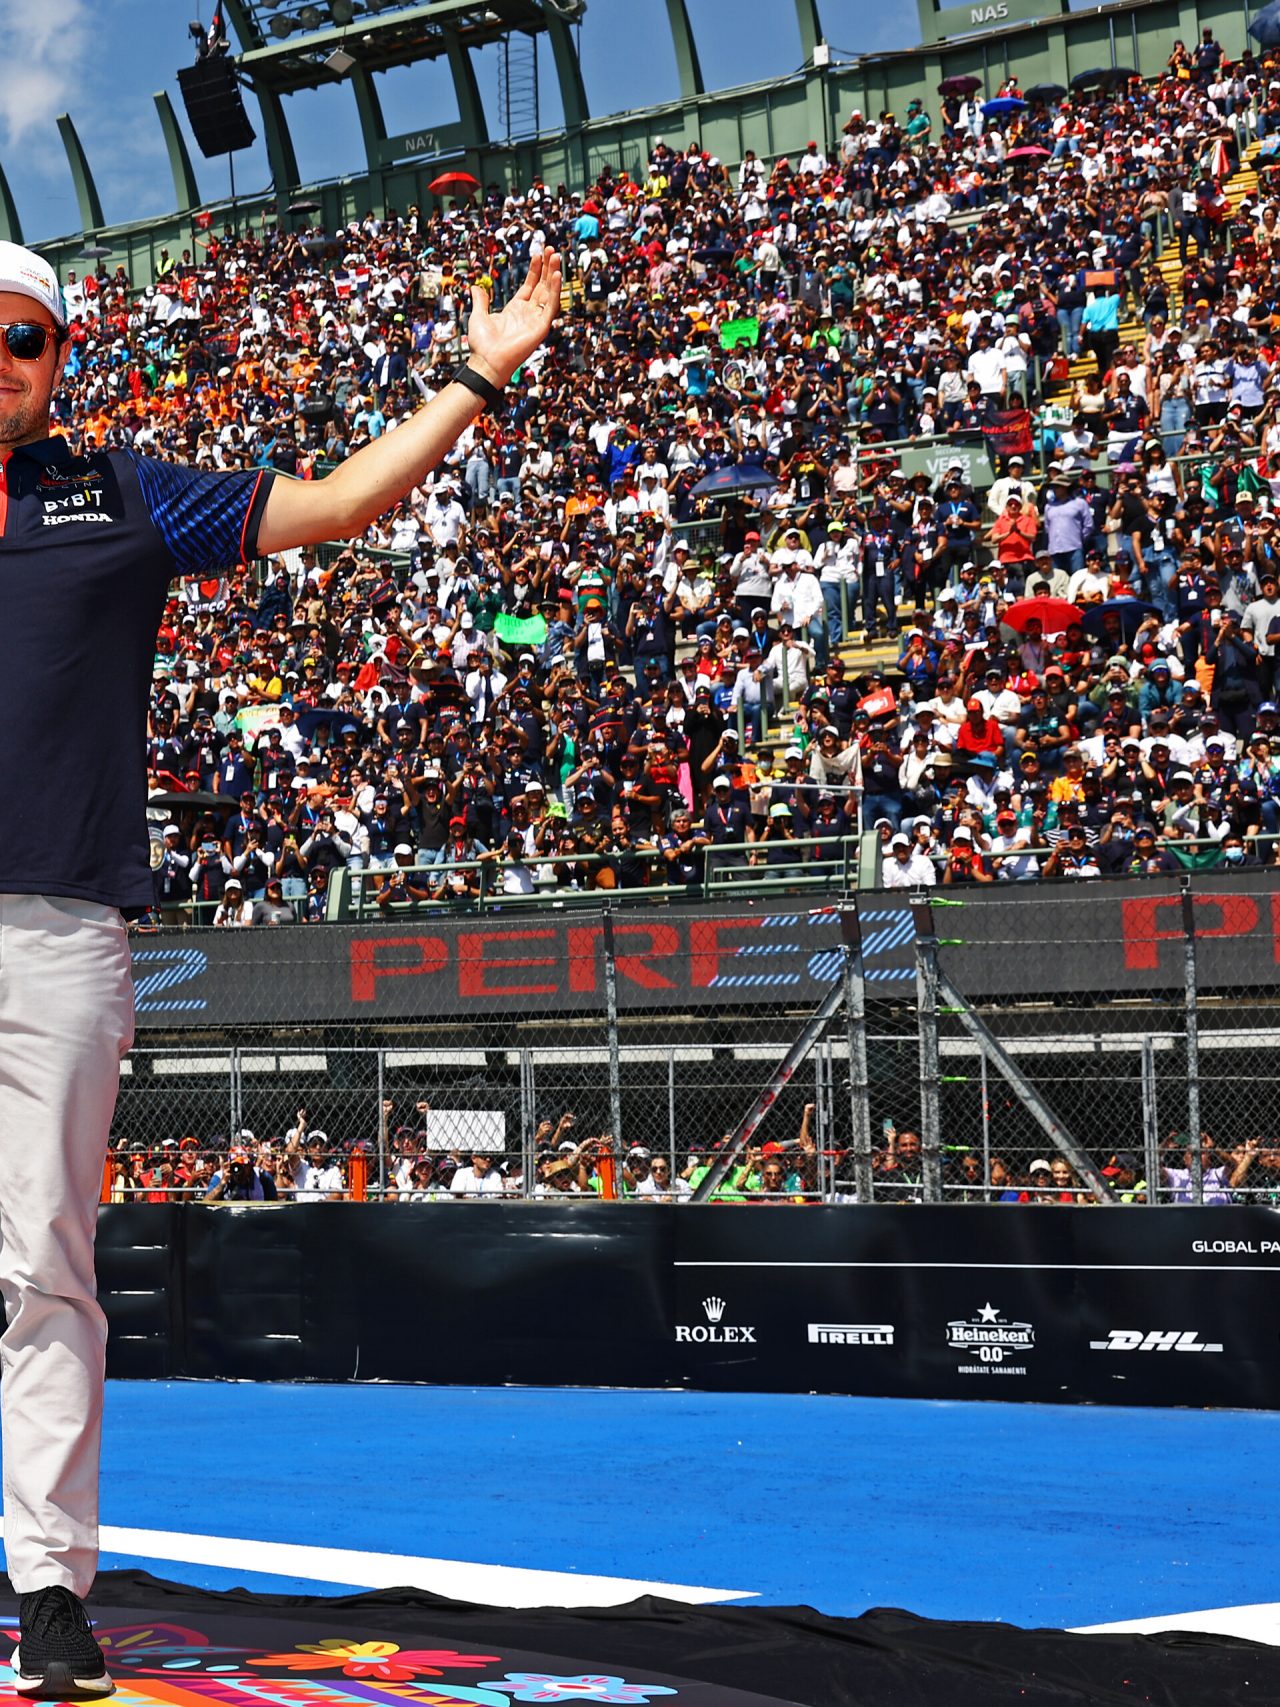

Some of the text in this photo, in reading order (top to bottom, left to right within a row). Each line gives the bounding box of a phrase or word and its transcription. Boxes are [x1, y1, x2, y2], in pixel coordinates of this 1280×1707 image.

[971, 2, 1009, 25] NA5
[405, 133, 434, 152] NA7
[43, 489, 103, 513] BYBIT
[42, 512, 113, 526] HONDA
[350, 910, 917, 1002] PEREZ
[1192, 1240, 1258, 1253] GLOBAL
[675, 1325, 757, 1343] ROLEX
[807, 1323, 895, 1345] PIRELLI
[951, 1327, 1029, 1343] Heineken
[1107, 1330, 1206, 1351] DHL
[980, 1346, 1003, 1362] 0.0
